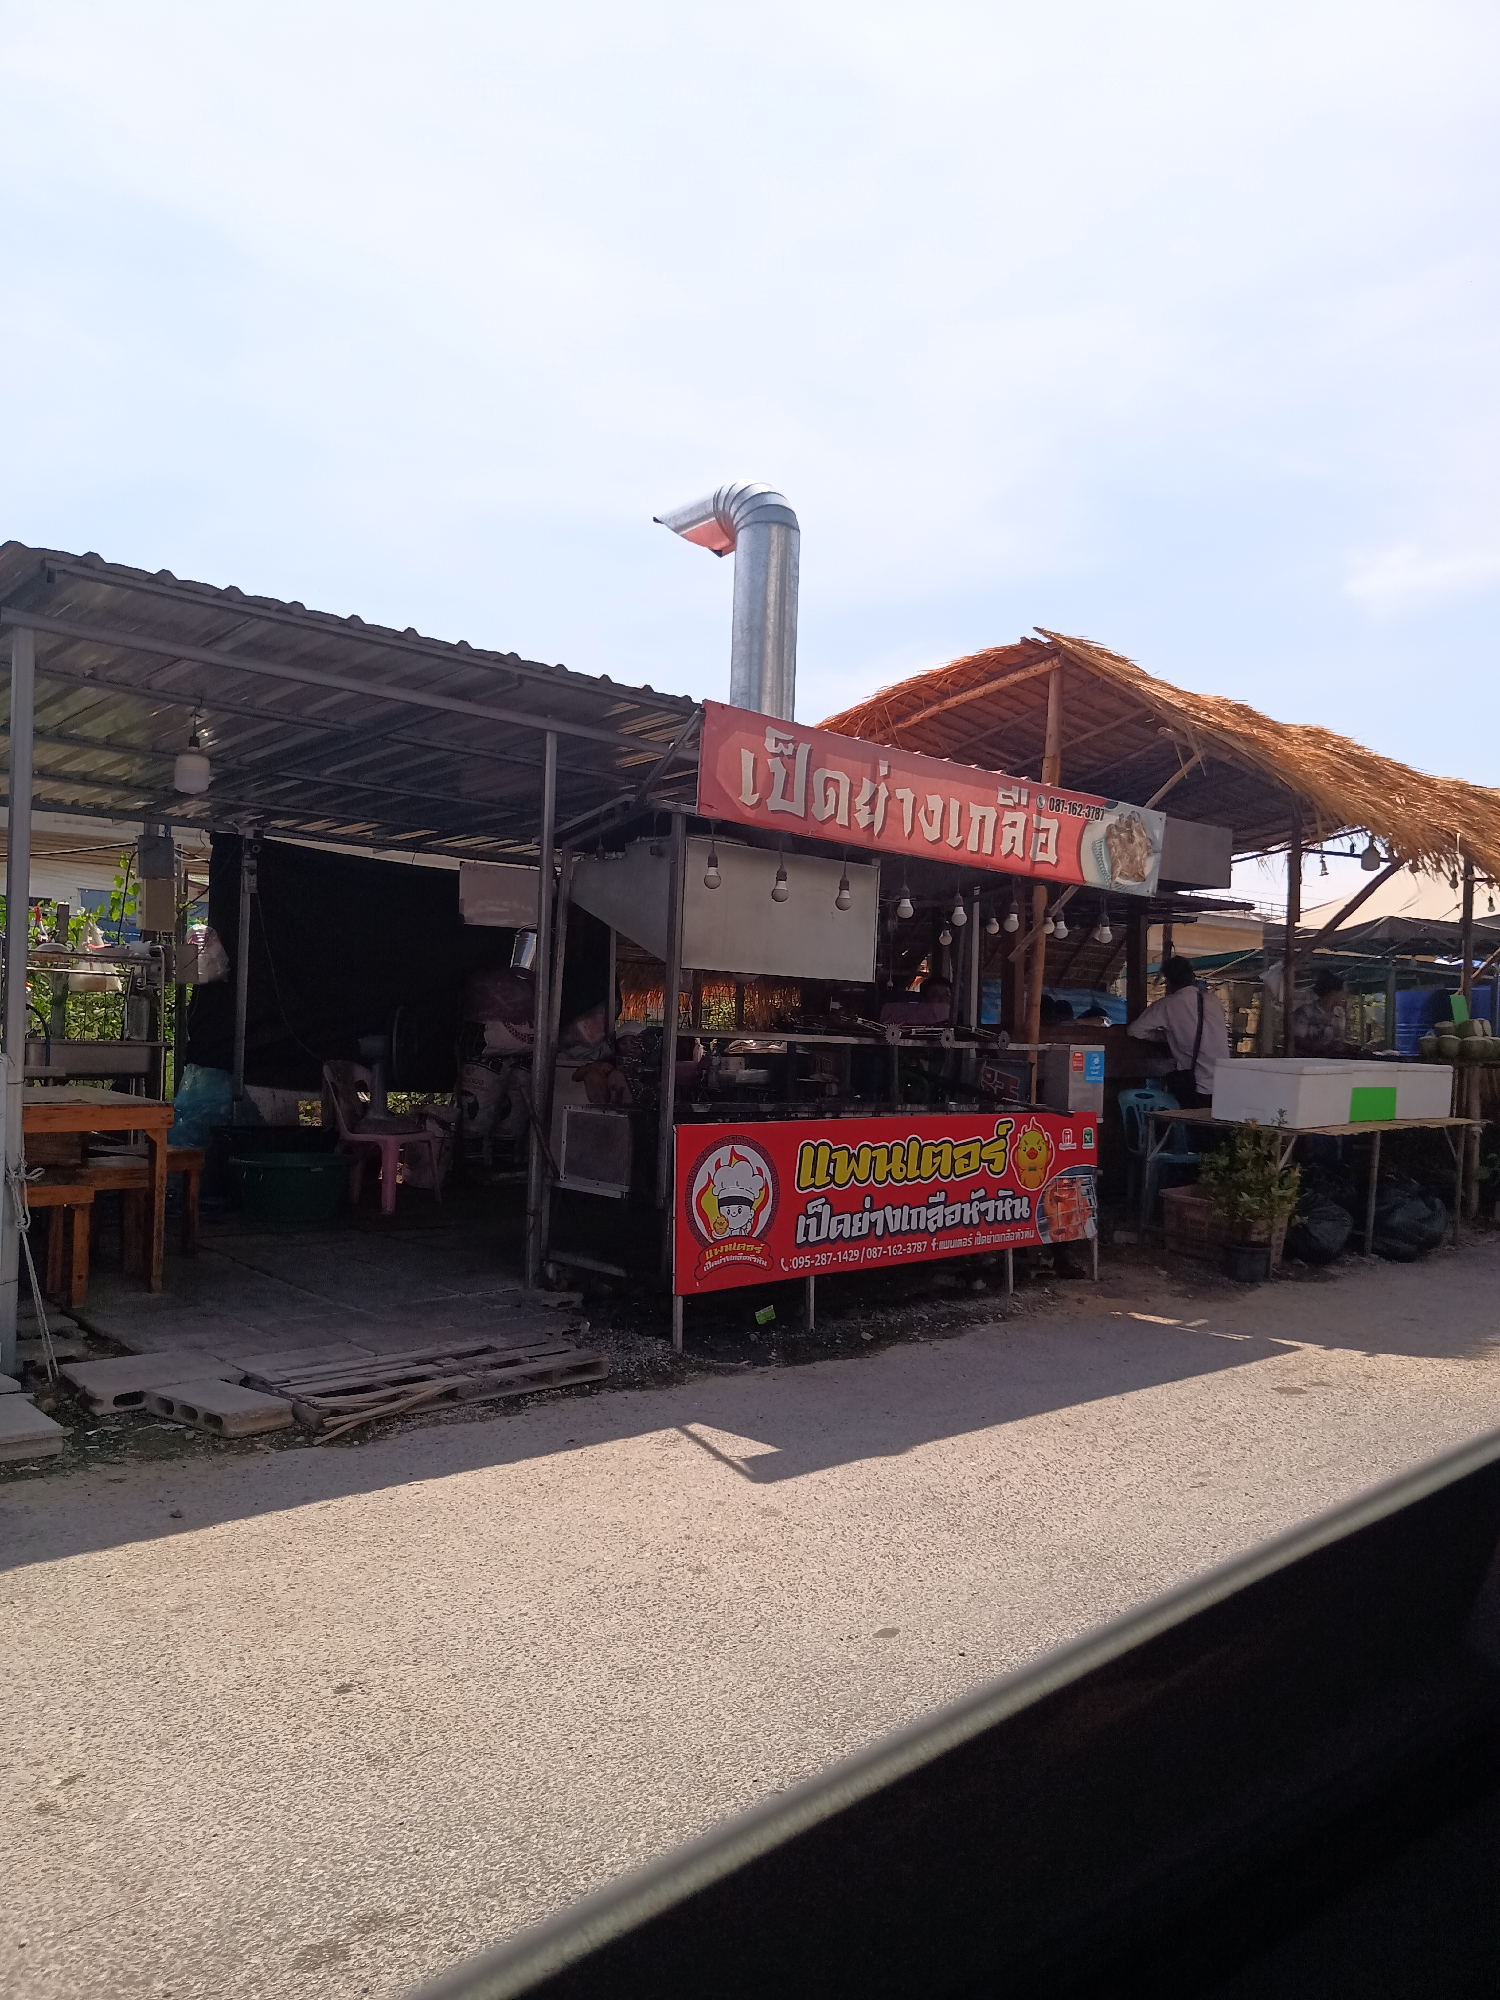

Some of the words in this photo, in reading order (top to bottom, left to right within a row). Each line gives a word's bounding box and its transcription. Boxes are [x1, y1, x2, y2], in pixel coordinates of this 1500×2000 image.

[738, 725, 1060, 866] เป็ดย่างเกลือ
[1048, 797, 1105, 821] 087-162-3787
[797, 1119, 1014, 1190] แพนเตอร์
[796, 1188, 1031, 1244] เป็ดย่างเกลือหัวหิน
[705, 1241, 765, 1260] แพนเตอร์
